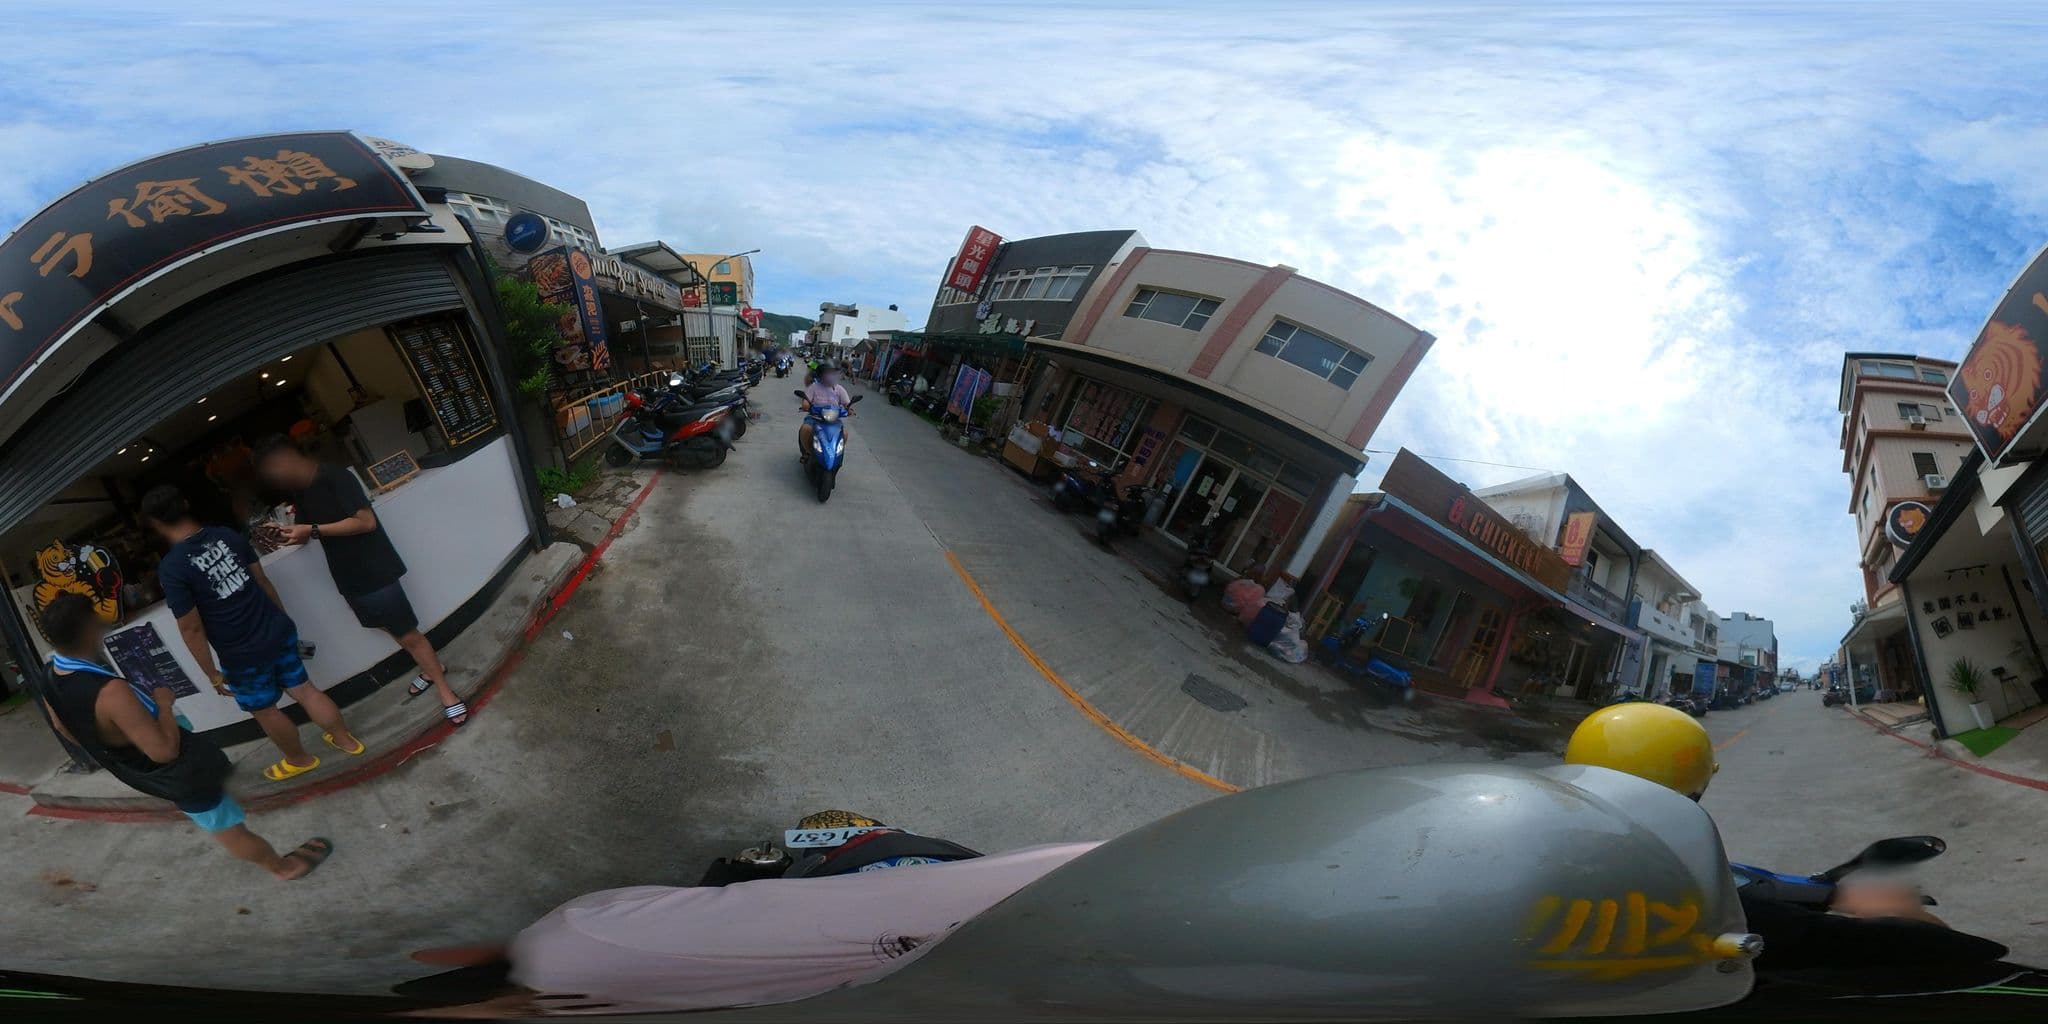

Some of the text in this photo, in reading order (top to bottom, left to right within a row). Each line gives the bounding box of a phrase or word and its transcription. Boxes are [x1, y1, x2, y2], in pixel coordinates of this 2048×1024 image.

[194, 540, 230, 572] RIDE
[208, 555, 239, 582] THE
[216, 566, 250, 600] WAVE
